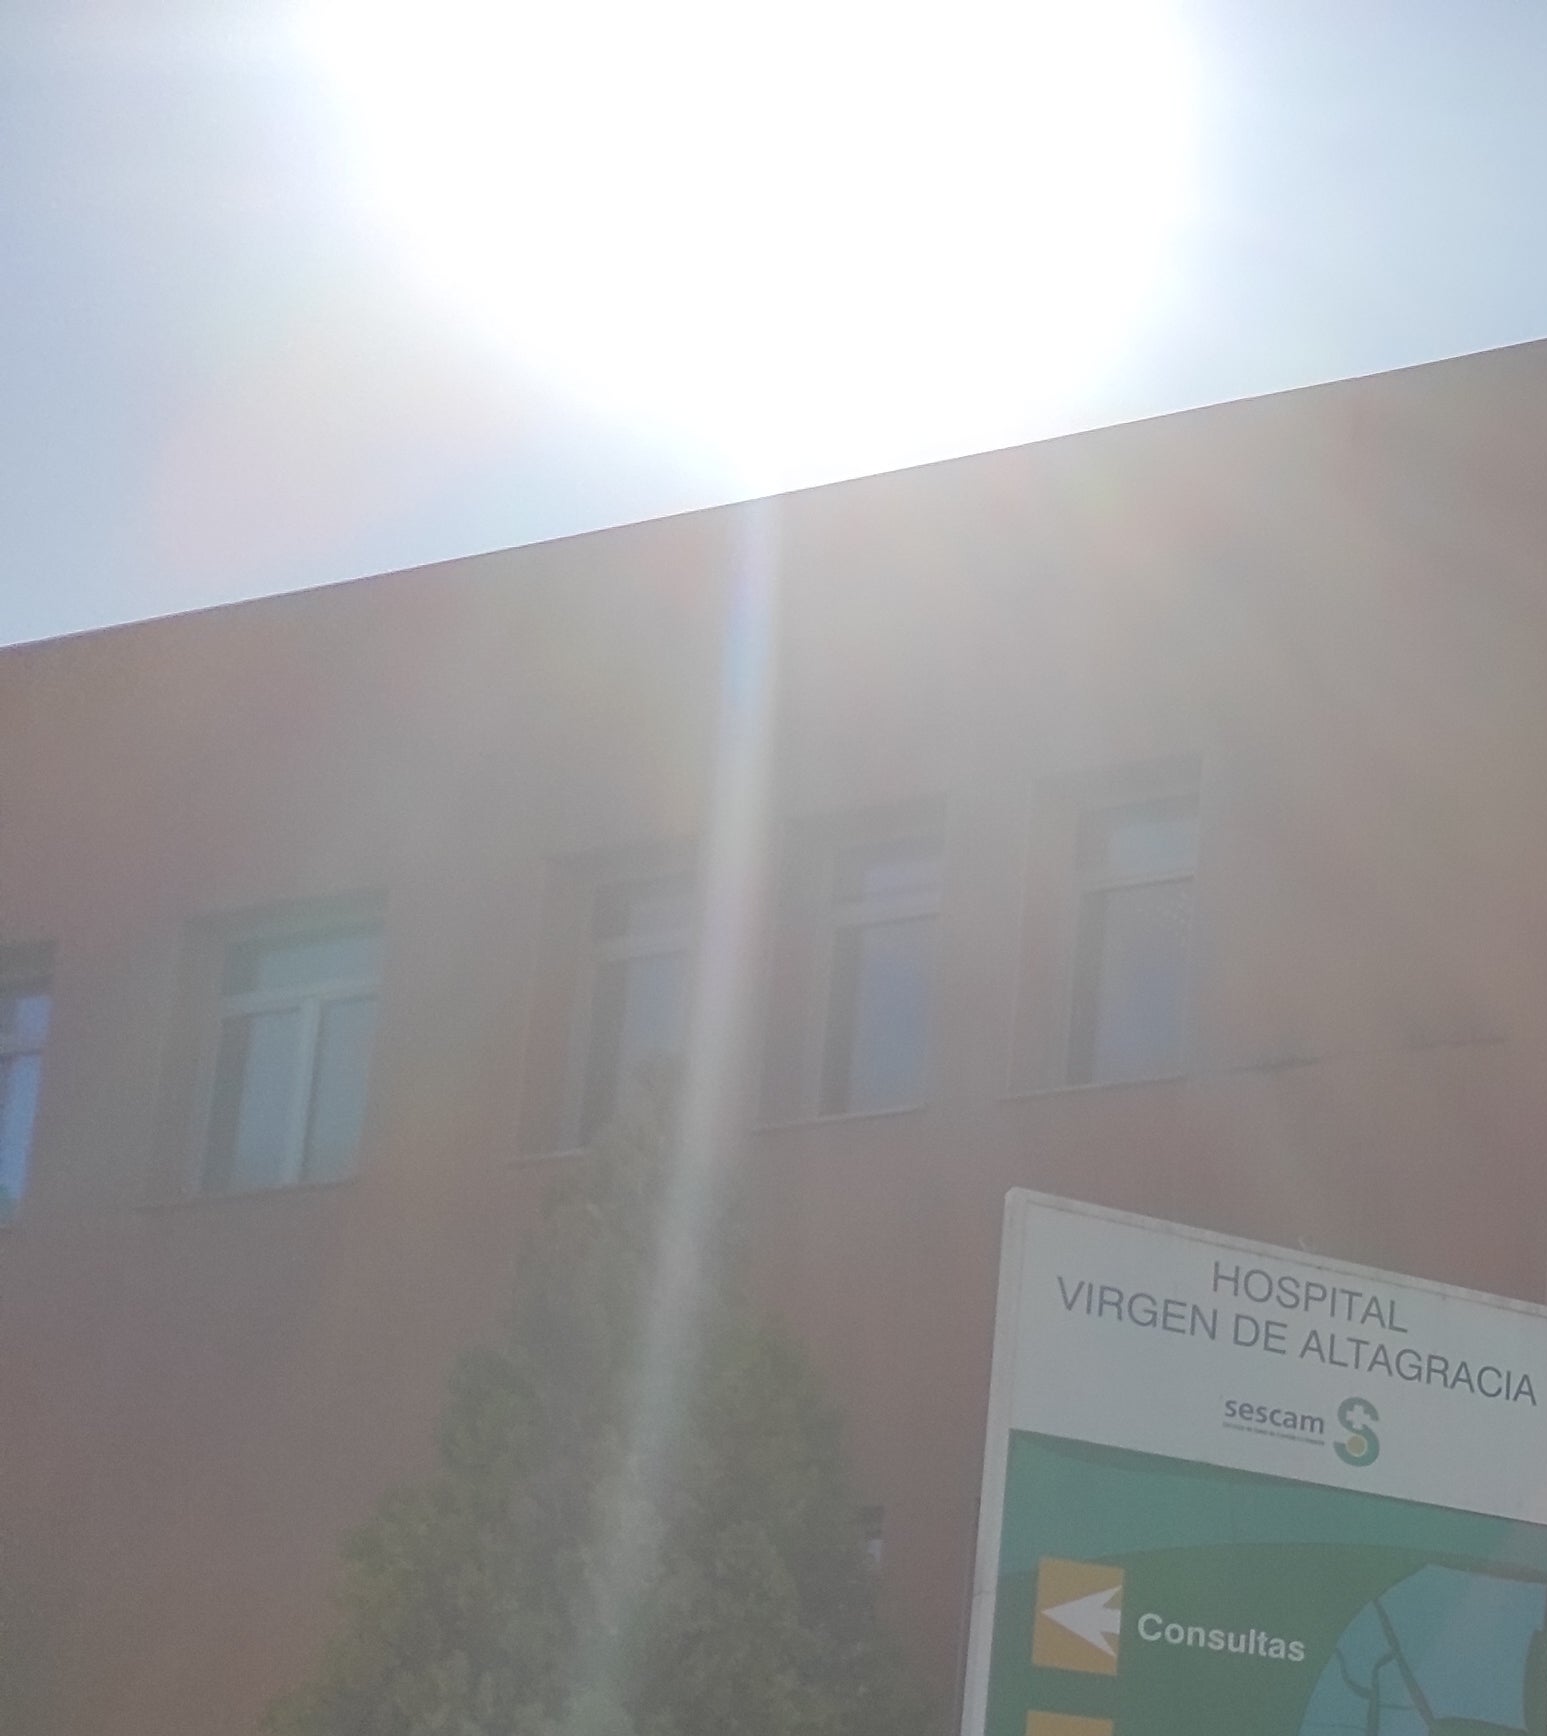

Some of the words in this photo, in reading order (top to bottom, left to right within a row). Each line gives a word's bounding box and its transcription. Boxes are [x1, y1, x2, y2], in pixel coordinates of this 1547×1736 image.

[1213, 1261, 1408, 1333] HOSPITAL
[1058, 1276, 1217, 1340] VIRGEN
[1233, 1313, 1288, 1354] DE
[1300, 1329, 1537, 1406] ALTAGRACIA
[1225, 1399, 1325, 1434] sescam
[1137, 1613, 1305, 1662] Consultas
